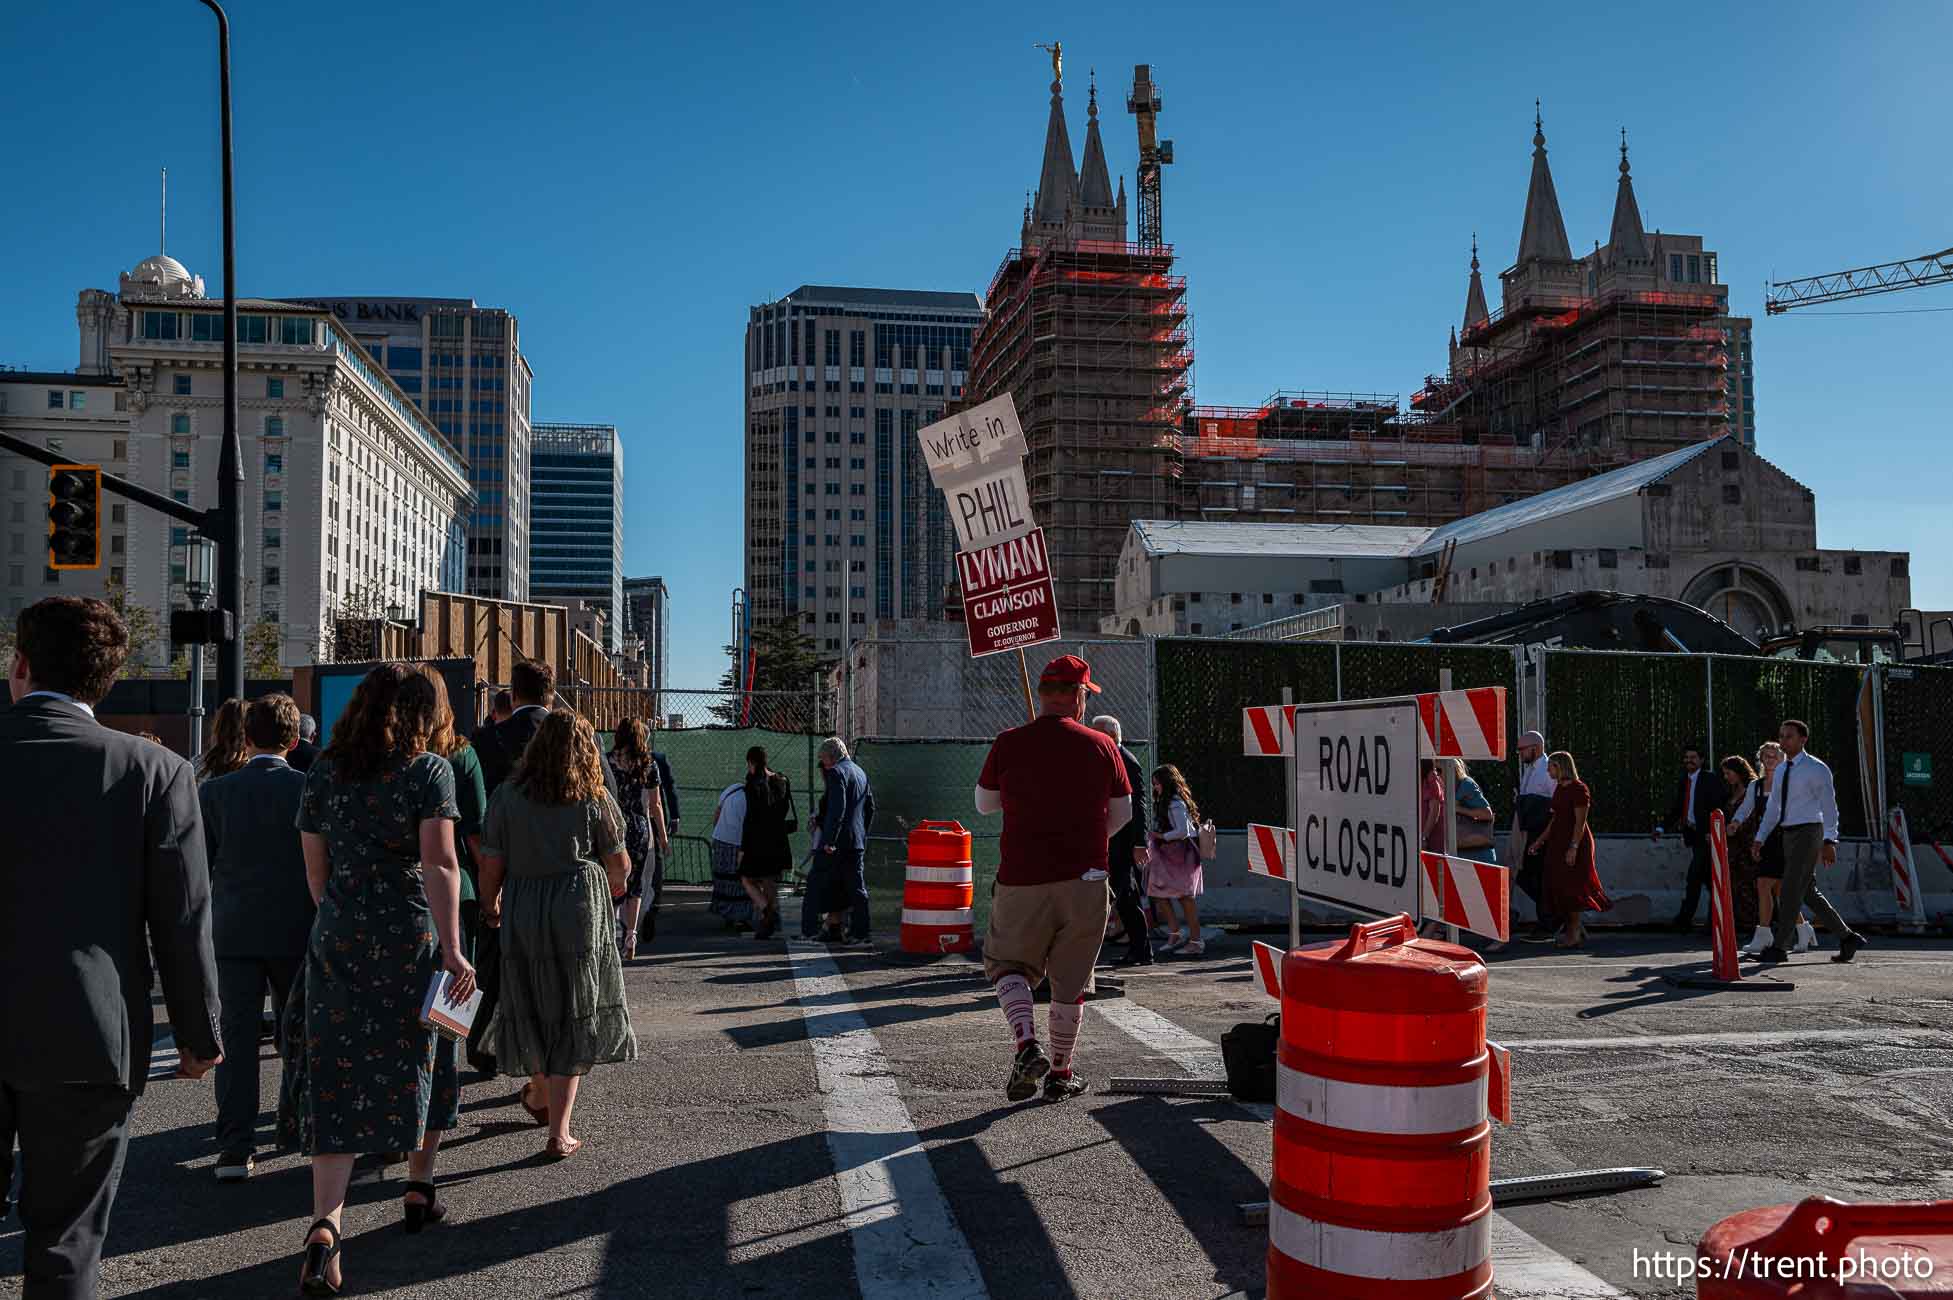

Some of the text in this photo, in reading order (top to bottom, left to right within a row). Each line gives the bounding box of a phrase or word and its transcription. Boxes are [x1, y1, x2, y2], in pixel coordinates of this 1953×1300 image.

[358, 303, 418, 319] BANK
[927, 416, 1005, 459] Write in
[957, 479, 1025, 541] PHIL
[962, 533, 1043, 592] LYMAN
[973, 586, 1046, 620] CLAWSON
[987, 617, 1040, 639] GOVERNOR
[1319, 735, 1392, 796] ROAD
[1305, 814, 1408, 889] CLOSED
